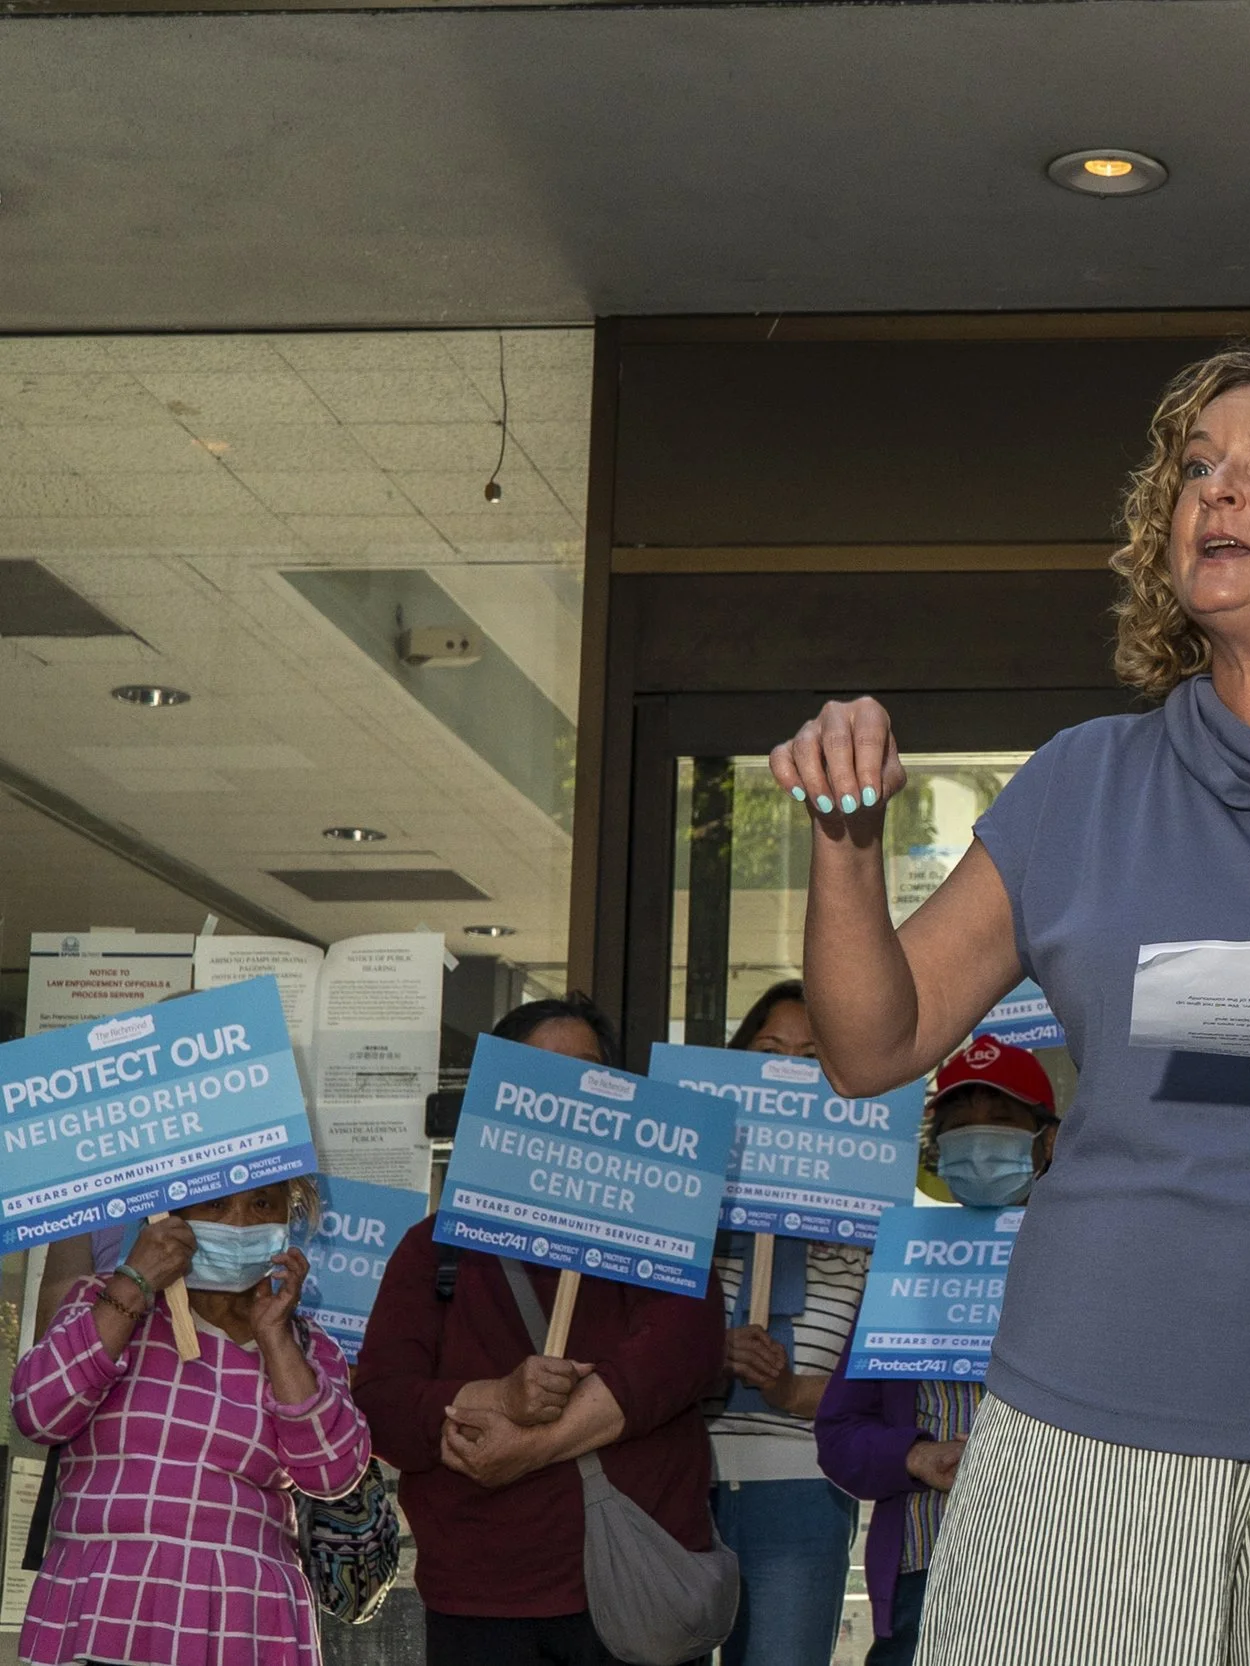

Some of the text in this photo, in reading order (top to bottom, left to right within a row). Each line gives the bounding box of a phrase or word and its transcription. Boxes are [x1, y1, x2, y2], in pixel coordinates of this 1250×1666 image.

[72, 991, 144, 999] PROCESS SERVERS
[1000, 1003, 1032, 1016] YEARS
[2, 1023, 251, 1114] PROTECT OUR
[4, 1063, 270, 1152] NEIGHBORHOOD
[823, 1096, 890, 1131] OUR
[495, 1081, 699, 1160] PROTECT OUR
[75, 1111, 203, 1163] CENTER
[735, 1123, 898, 1164] HBORHOOD
[7, 1131, 281, 1211] 45 YEARS OF COMMUNITY SERVICE AT 741
[249, 1156, 282, 1170] PROTECT
[250, 1161, 303, 1180] COMMUNITIES
[480, 1125, 701, 1198] NEIGHBORHOOD
[187, 1171, 221, 1187] PROTECT
[188, 1181, 222, 1196] FAMILIES
[126, 1190, 160, 1205] PROTECT
[529, 1169, 636, 1213] CENTER
[726, 1185, 798, 1201] COMMUNITY
[802, 1194, 850, 1208] SERVICE
[854, 1201, 867, 1210] AT
[127, 1202, 155, 1214] YOUTH
[2, 1206, 101, 1245] #Protect741
[318, 1211, 386, 1247] OUR
[457, 1193, 690, 1253] 45 YEARS OF COMMUNITY SERVICE AT 741
[442, 1219, 528, 1251] #Protect741
[550, 1242, 580, 1255] PROTECT
[603, 1252, 632, 1264] PROTECT
[904, 1240, 1012, 1266] PROTE
[654, 1263, 683, 1275] PROTECT
[891, 1278, 1004, 1298] NEIGHB
[340, 1317, 353, 1327] AT
[947, 1304, 1000, 1324] CEN
[869, 1336, 884, 1345] 45
[889, 1337, 927, 1345] YEARS
[932, 1338, 948, 1346] OF
[854, 1358, 947, 1373] #Protect741
